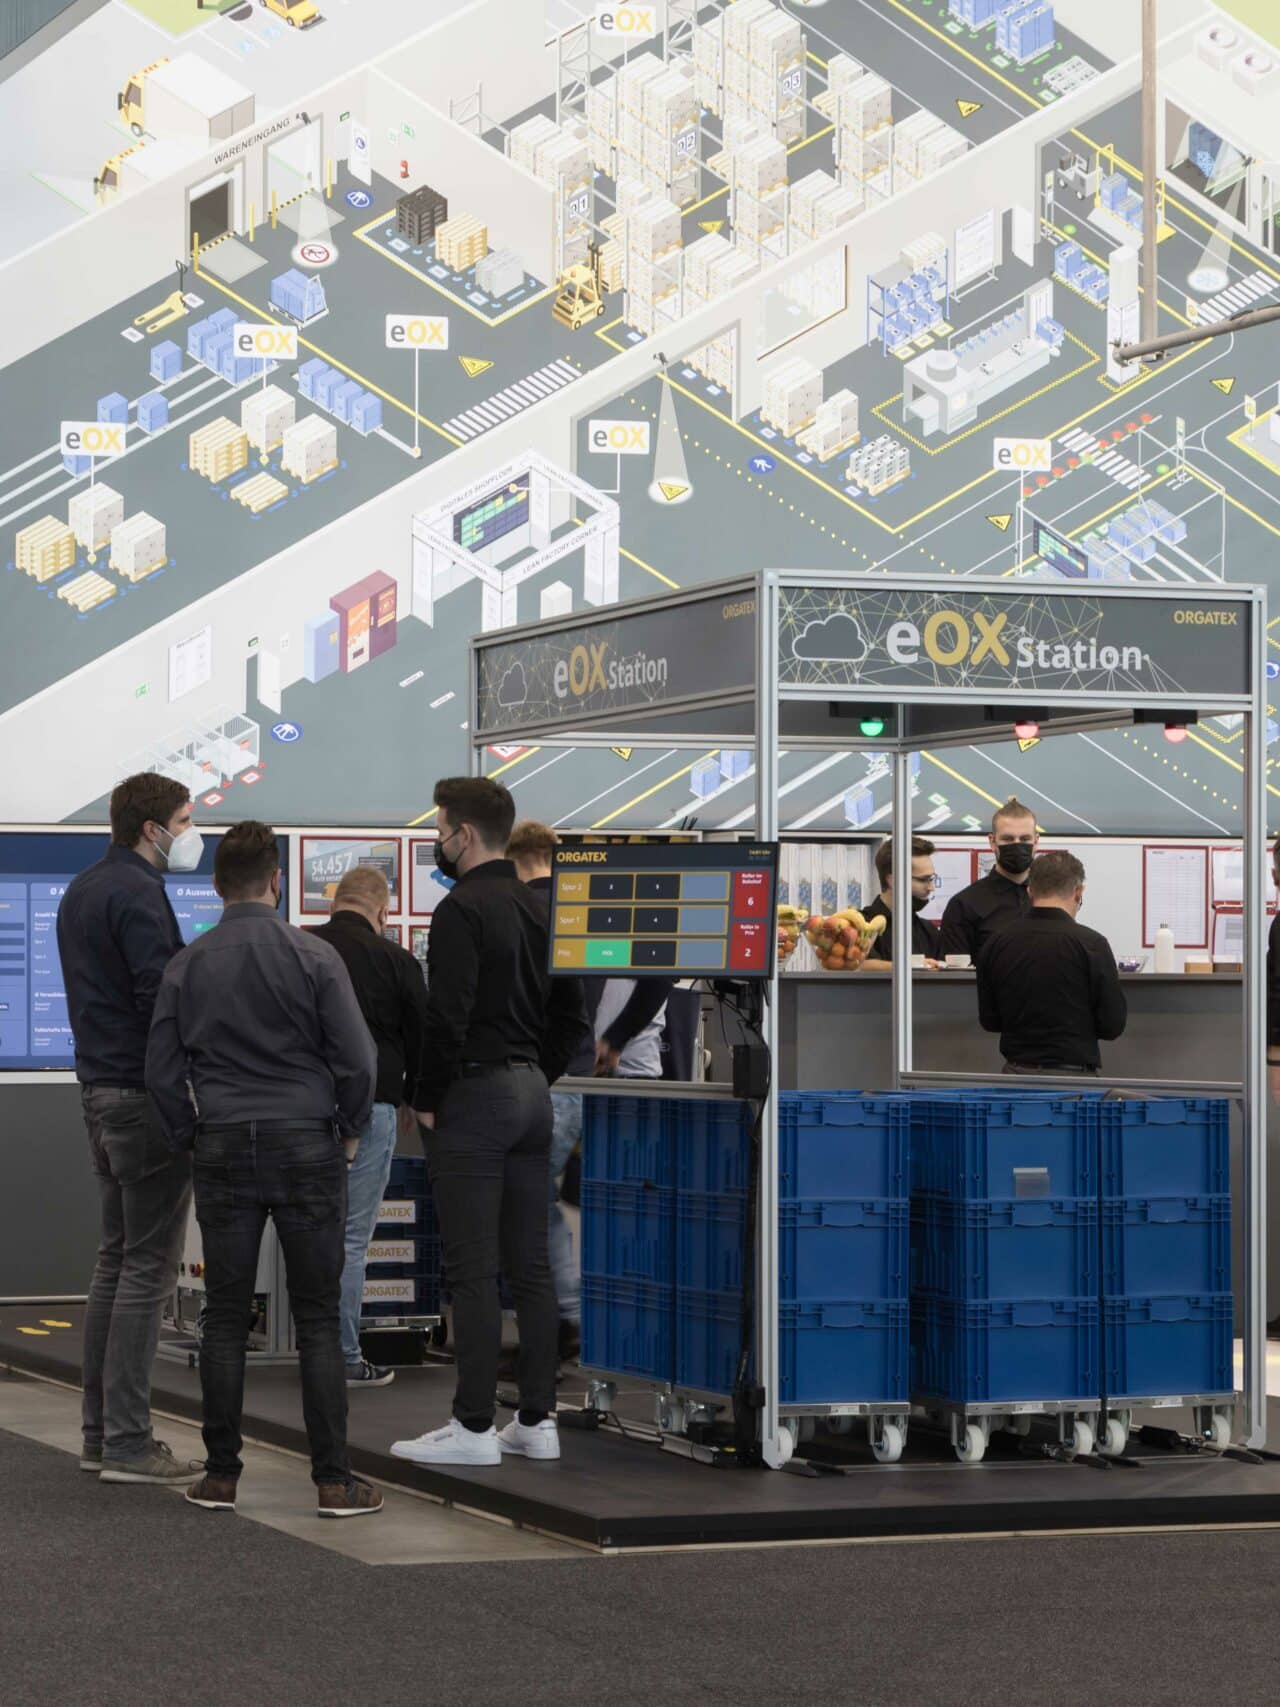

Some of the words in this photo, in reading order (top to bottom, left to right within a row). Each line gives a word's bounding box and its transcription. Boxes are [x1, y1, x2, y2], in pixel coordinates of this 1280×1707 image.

[599, 5, 652, 33] eOX
[214, 117, 290, 164] WARENEINGANG
[236, 328, 292, 354] eOX
[390, 319, 445, 345] eOX
[65, 425, 122, 452] eOX
[593, 424, 645, 450] eOX
[998, 443, 1049, 469] eOX
[1173, 610, 1237, 625] ORGATEX
[886, 609, 1010, 667] eOX
[1016, 636, 1143, 672] Station
[553, 642, 608, 698] eOX
[608, 652, 668, 690] Station
[556, 851, 608, 863] ORGATEX
[747, 897, 754, 906] 6
[744, 949, 751, 957] 2
[379, 1207, 411, 1217] GATEX
